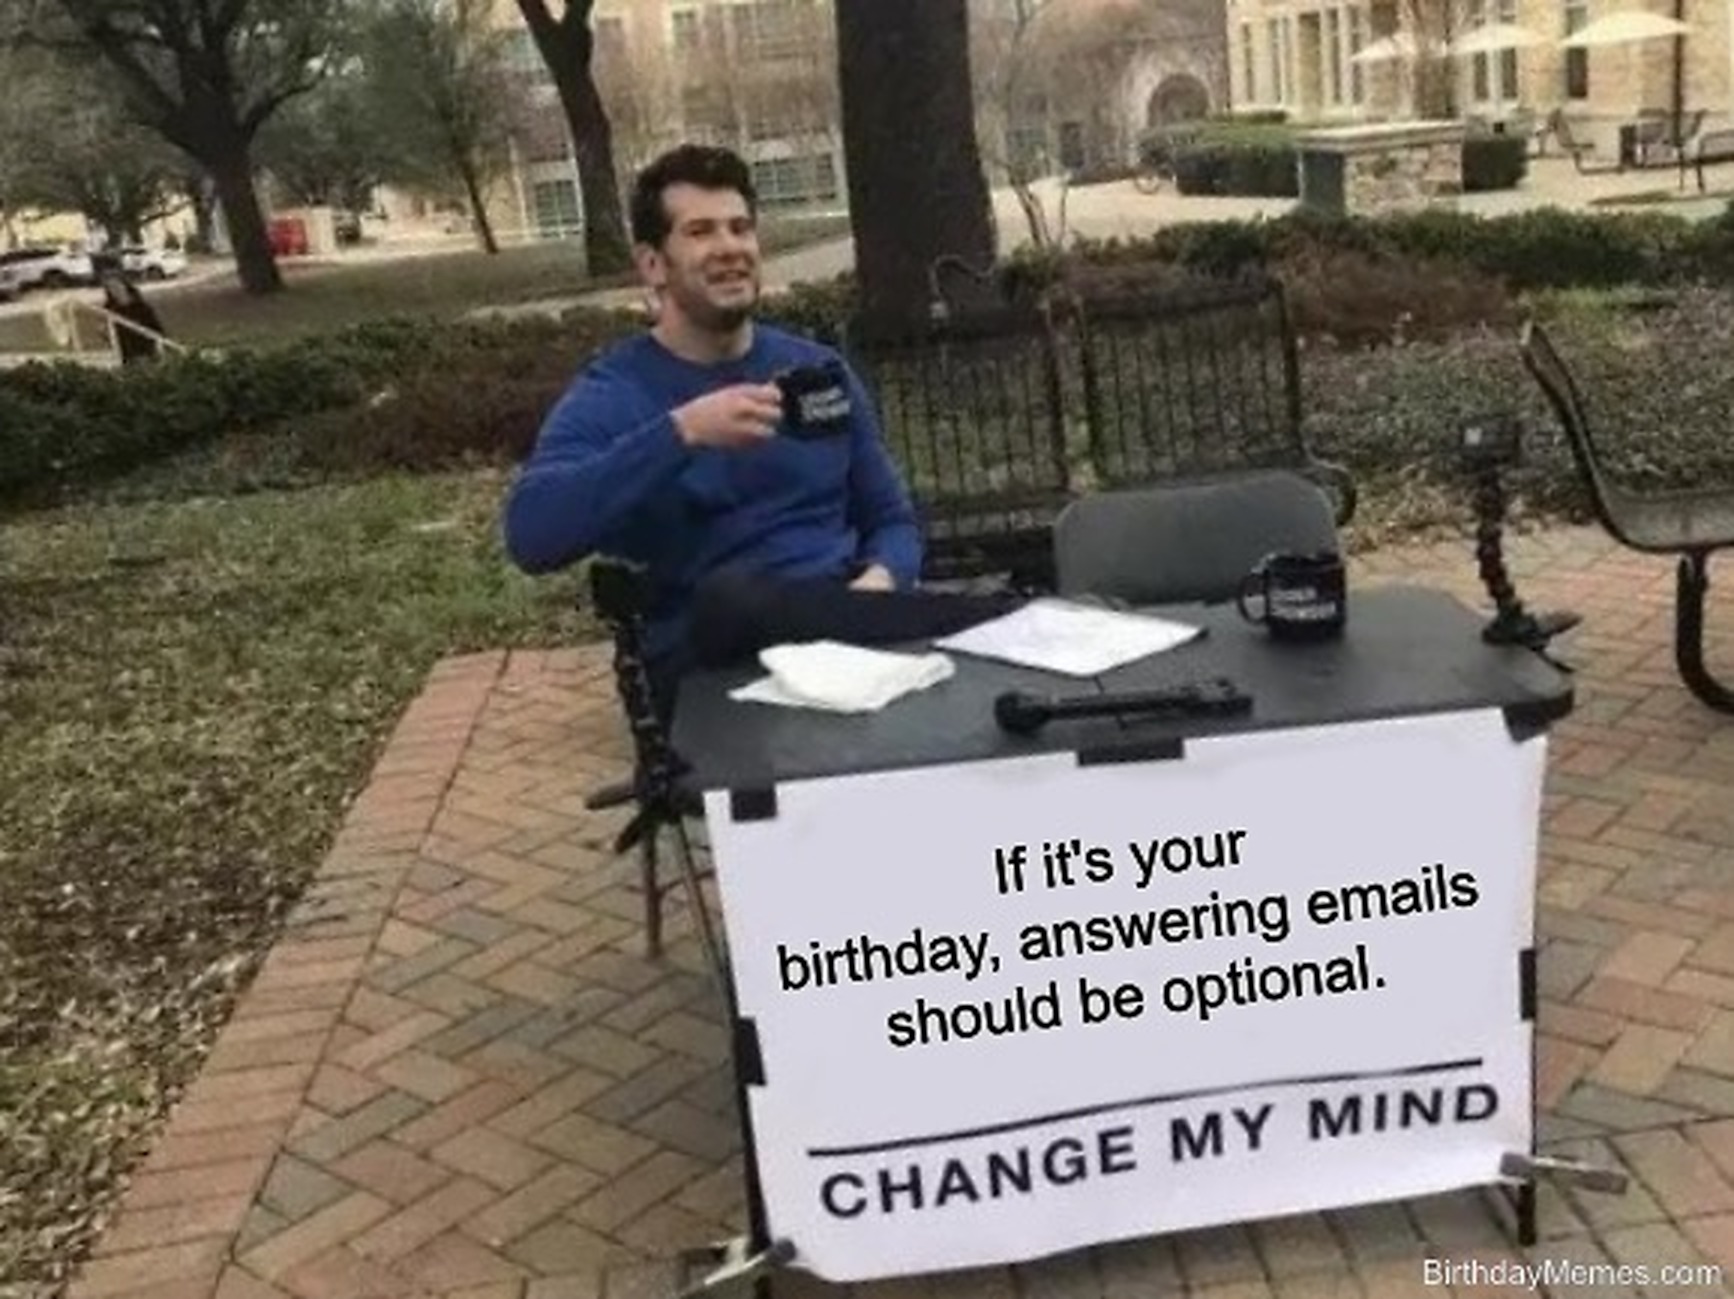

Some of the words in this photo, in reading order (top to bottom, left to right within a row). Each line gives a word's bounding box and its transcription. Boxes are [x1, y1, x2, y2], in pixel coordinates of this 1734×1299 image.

[820, 1125, 1137, 1219] CHANGE
[1170, 1103, 1273, 1163] MY
[1308, 1084, 1499, 1141] MIND
